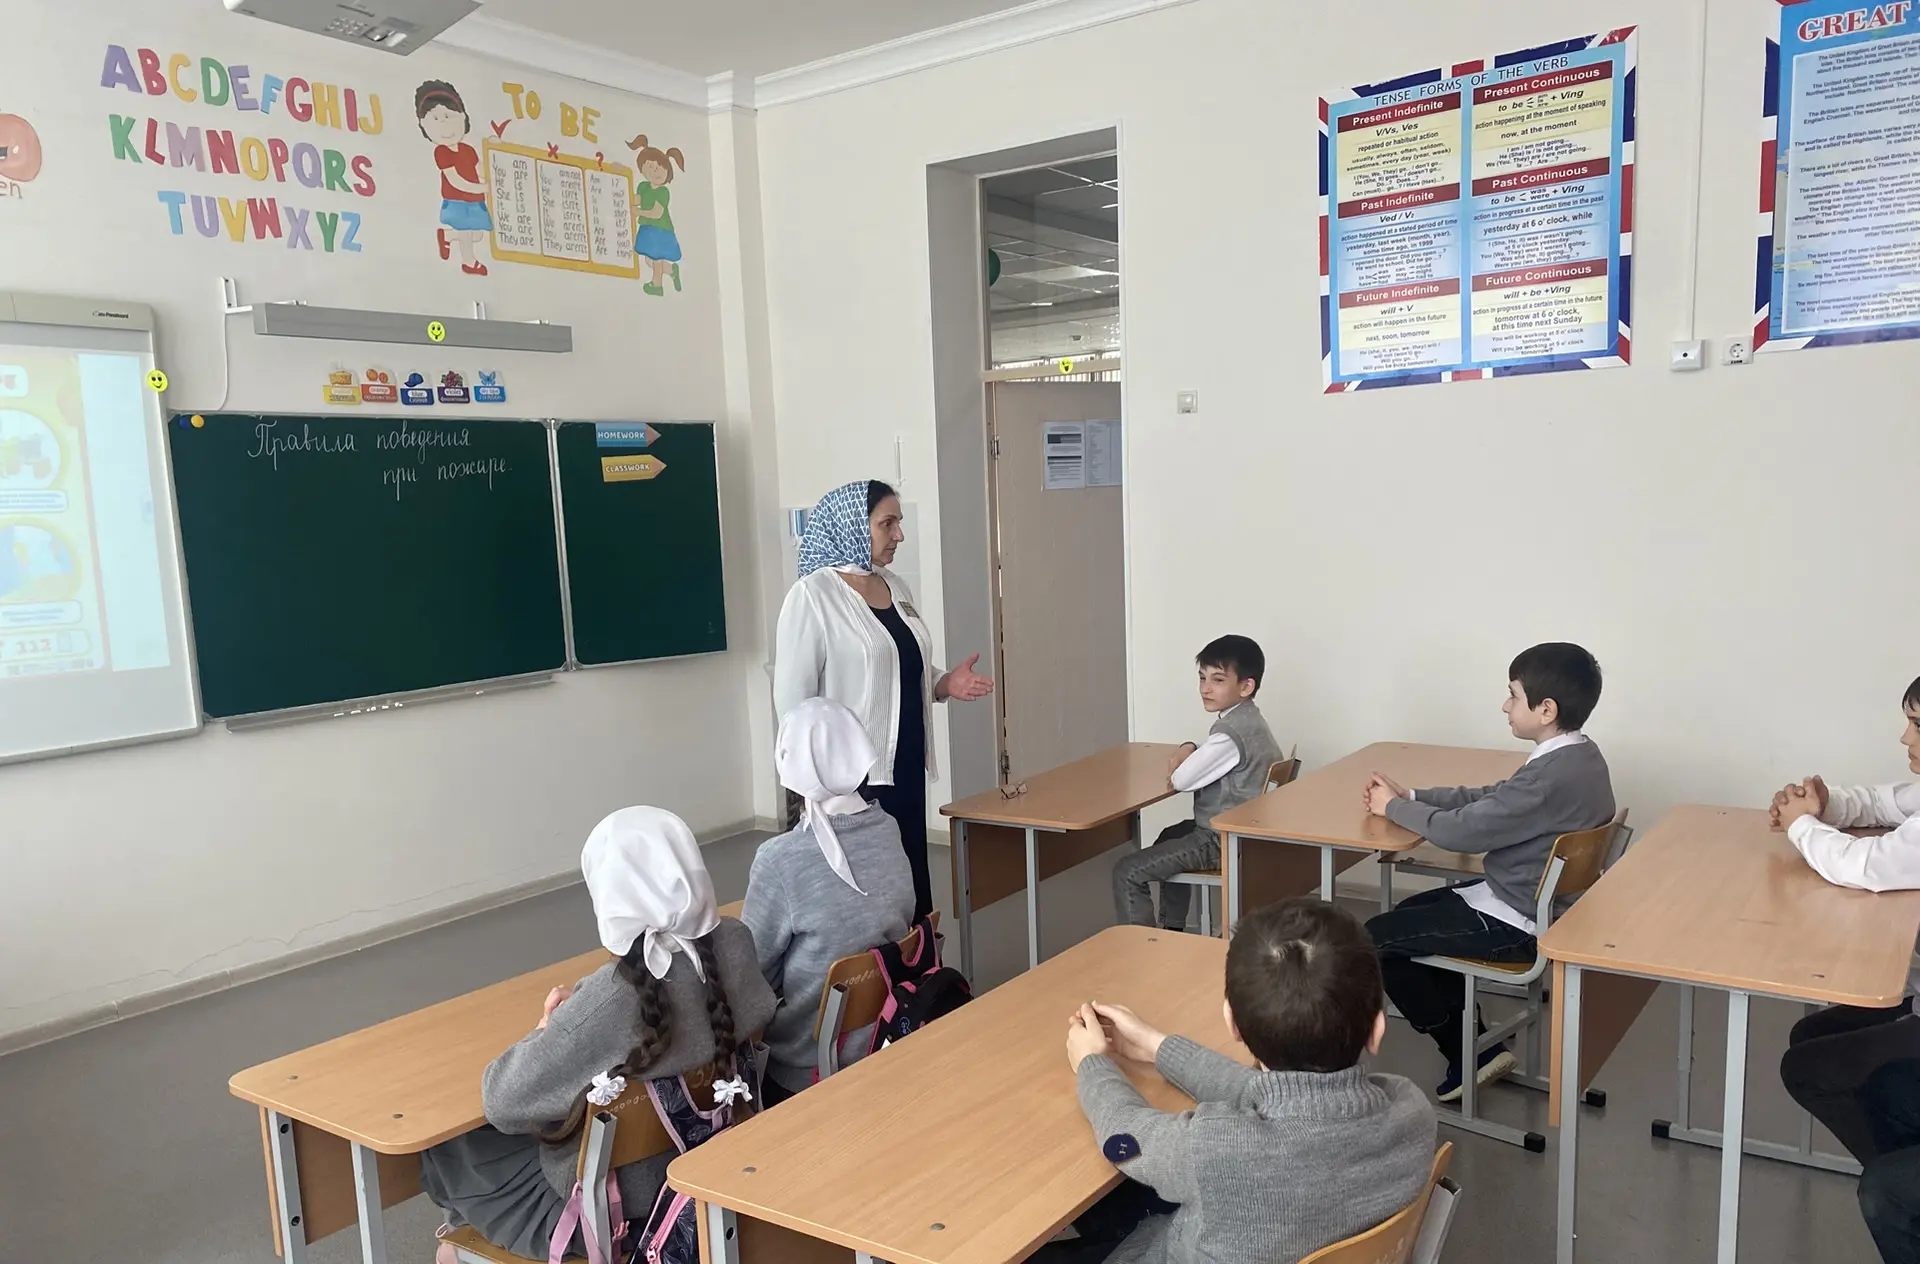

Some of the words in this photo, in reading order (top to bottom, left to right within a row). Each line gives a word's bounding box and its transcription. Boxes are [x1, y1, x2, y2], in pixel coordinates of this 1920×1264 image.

[1798, 2, 1911, 41] GREAT
[1374, 90, 1411, 108] TENSE
[1420, 78, 1462, 96] FORMS
[1471, 73, 1488, 85] OF
[1498, 66, 1524, 80] THE
[1534, 57, 1568, 72] VERB
[1484, 83, 1528, 98] Present
[1532, 69, 1600, 88] Continuous
[1512, 101, 1523, 109] be
[1560, 90, 1584, 100] Ving
[502, 82, 541, 120] TO
[560, 102, 601, 143] BE
[1353, 110, 1391, 125] Present
[1395, 101, 1443, 117] Indefinite
[1475, 121, 1492, 129] action
[1494, 115, 1524, 127] happening
[1544, 107, 1569, 116] moment
[1578, 100, 1606, 111] speaking
[1530, 126, 1543, 134] the
[1544, 120, 1576, 131] moment
[1358, 141, 1384, 152] repeated
[1393, 135, 1418, 145] habitual
[1419, 132, 1438, 140] action
[1492, 179, 1517, 188] Past
[1521, 166, 1588, 183] Continuous
[1562, 185, 1585, 194] Ving
[1361, 202, 1383, 210] Past
[1386, 193, 1434, 206] Indefinite
[1499, 208, 1524, 218] progress
[1537, 203, 1557, 211] certain
[1590, 195, 1604, 203] past
[1380, 214, 1396, 222] Ved
[1484, 223, 1520, 235] yesterday
[1546, 215, 1569, 225] clock,
[1572, 212, 1592, 221] while
[498, 232, 518, 245] They
[1359, 230, 1386, 239] happened
[1418, 222, 1436, 231] period
[1391, 236, 1406, 244] week
[1364, 247, 1380, 255] some
[1486, 275, 1521, 286] Future
[1525, 266, 1592, 281] Continuous
[1357, 291, 1388, 302] Future
[1391, 285, 1440, 298] Indefinite
[1504, 290, 1520, 300] will
[1530, 288, 1542, 296] be
[1380, 307, 1396, 315] will
[1407, 304, 1414, 312] V
[1497, 304, 1521, 313] progress
[1534, 300, 1553, 308] certain
[1575, 295, 1584, 303] the
[1585, 294, 1602, 302] future
[1353, 321, 1372, 329] action
[1385, 317, 1407, 328] happen
[1495, 314, 1530, 323] tomorrow
[1557, 307, 1580, 316] clock,
[1501, 322, 1515, 330] this
[1516, 320, 1533, 329] time
[1535, 318, 1551, 326] next
[1554, 315, 1583, 326] Sunday
[1400, 330, 1430, 338] tomorrow
[248, 415, 358, 471] Правила
[376, 420, 471, 464] поведения
[606, 464, 649, 472] CLASSWORK
[383, 466, 418, 501] при
